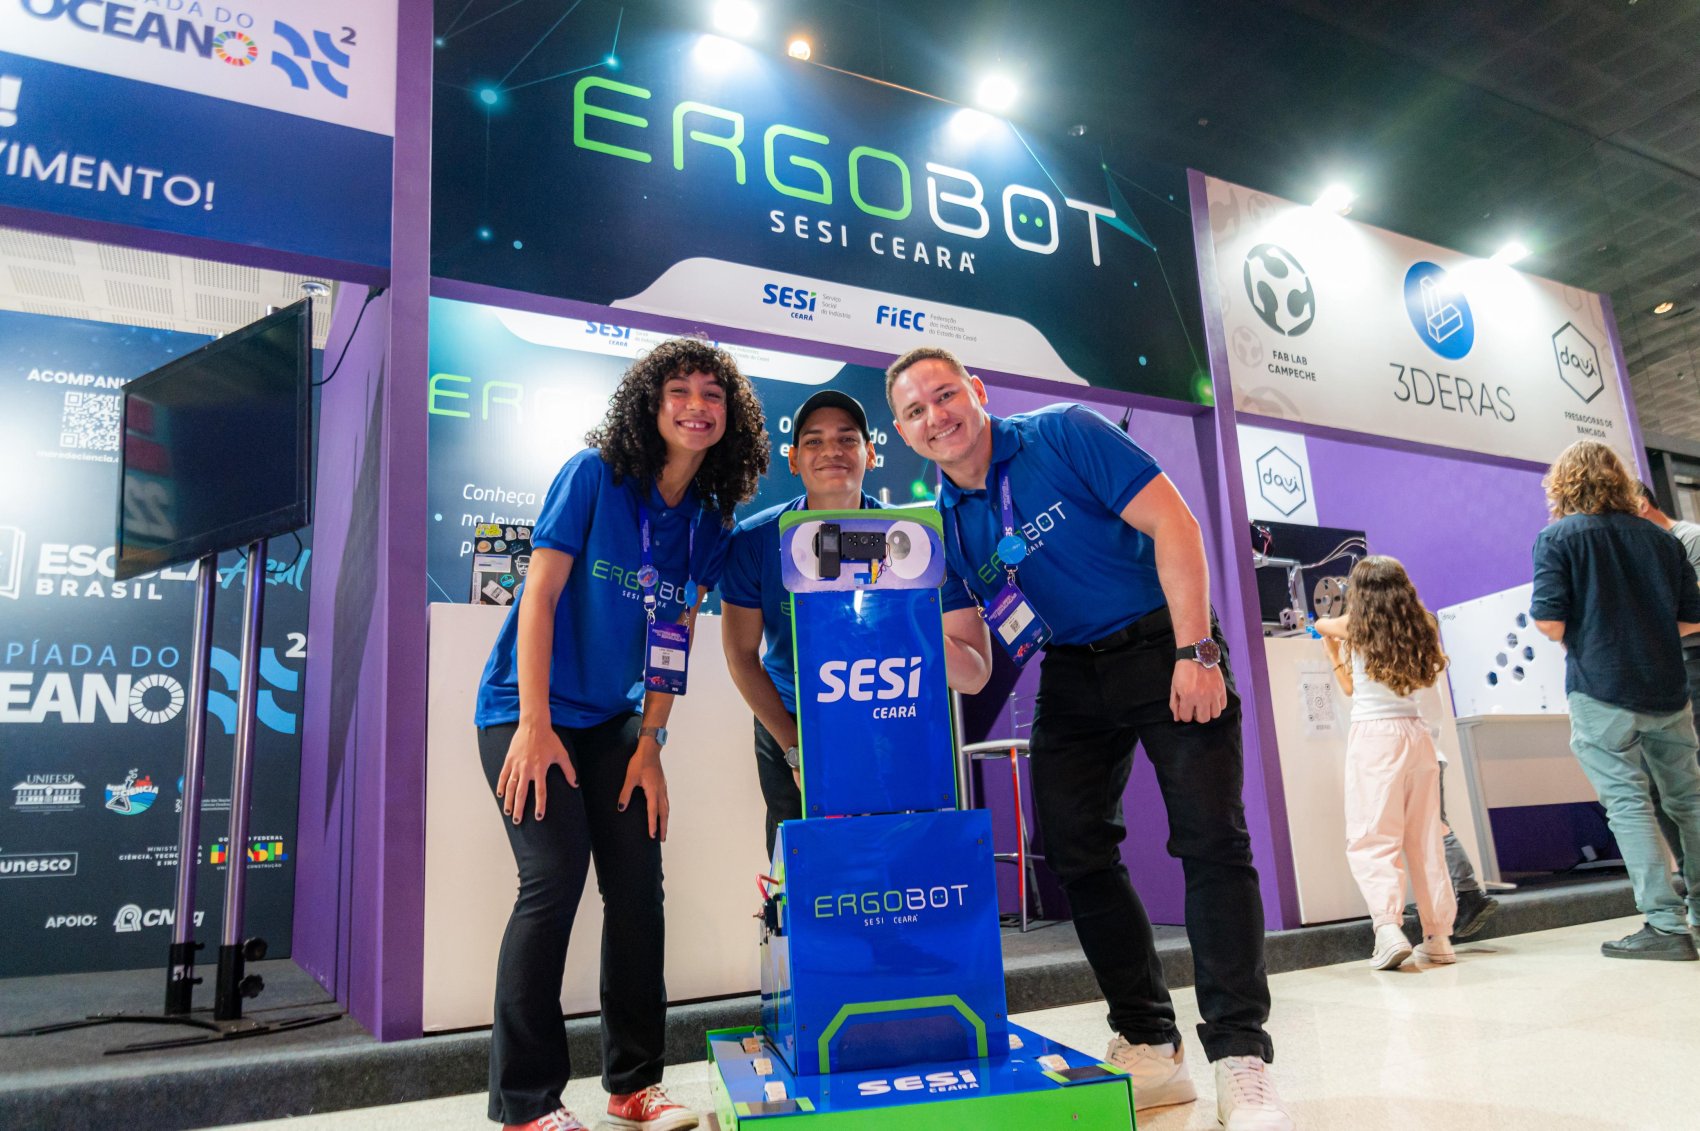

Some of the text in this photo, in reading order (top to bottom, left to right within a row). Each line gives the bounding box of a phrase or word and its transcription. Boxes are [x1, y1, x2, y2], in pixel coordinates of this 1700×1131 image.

[215, 7, 254, 28] DO
[340, 26, 357, 46] 2
[0, 142, 215, 211] IMENTO!
[573, 76, 1115, 267] ERGOBOT
[770, 209, 976, 274] SESI CEARÁ
[790, 312, 813, 321] CEARÁ
[1272, 350, 1307, 366] FAB LAB
[1268, 363, 1317, 381] CAMPECHE
[1390, 362, 1515, 422] 3DERAS
[462, 483, 536, 507] Conheça
[978, 501, 1066, 584] ERBOT
[36, 579, 162, 600] BRASIL
[285, 632, 307, 658] 2
[131, 646, 179, 668] DO
[872, 701, 917, 719] CEARÁ
[26, 773, 75, 784] UNIFESP
[0, 857, 72, 873] unesco
[814, 883, 969, 919] ERGOBOT
[45, 909, 205, 929] APOIO: CNq
[864, 916, 885, 927] SESI
